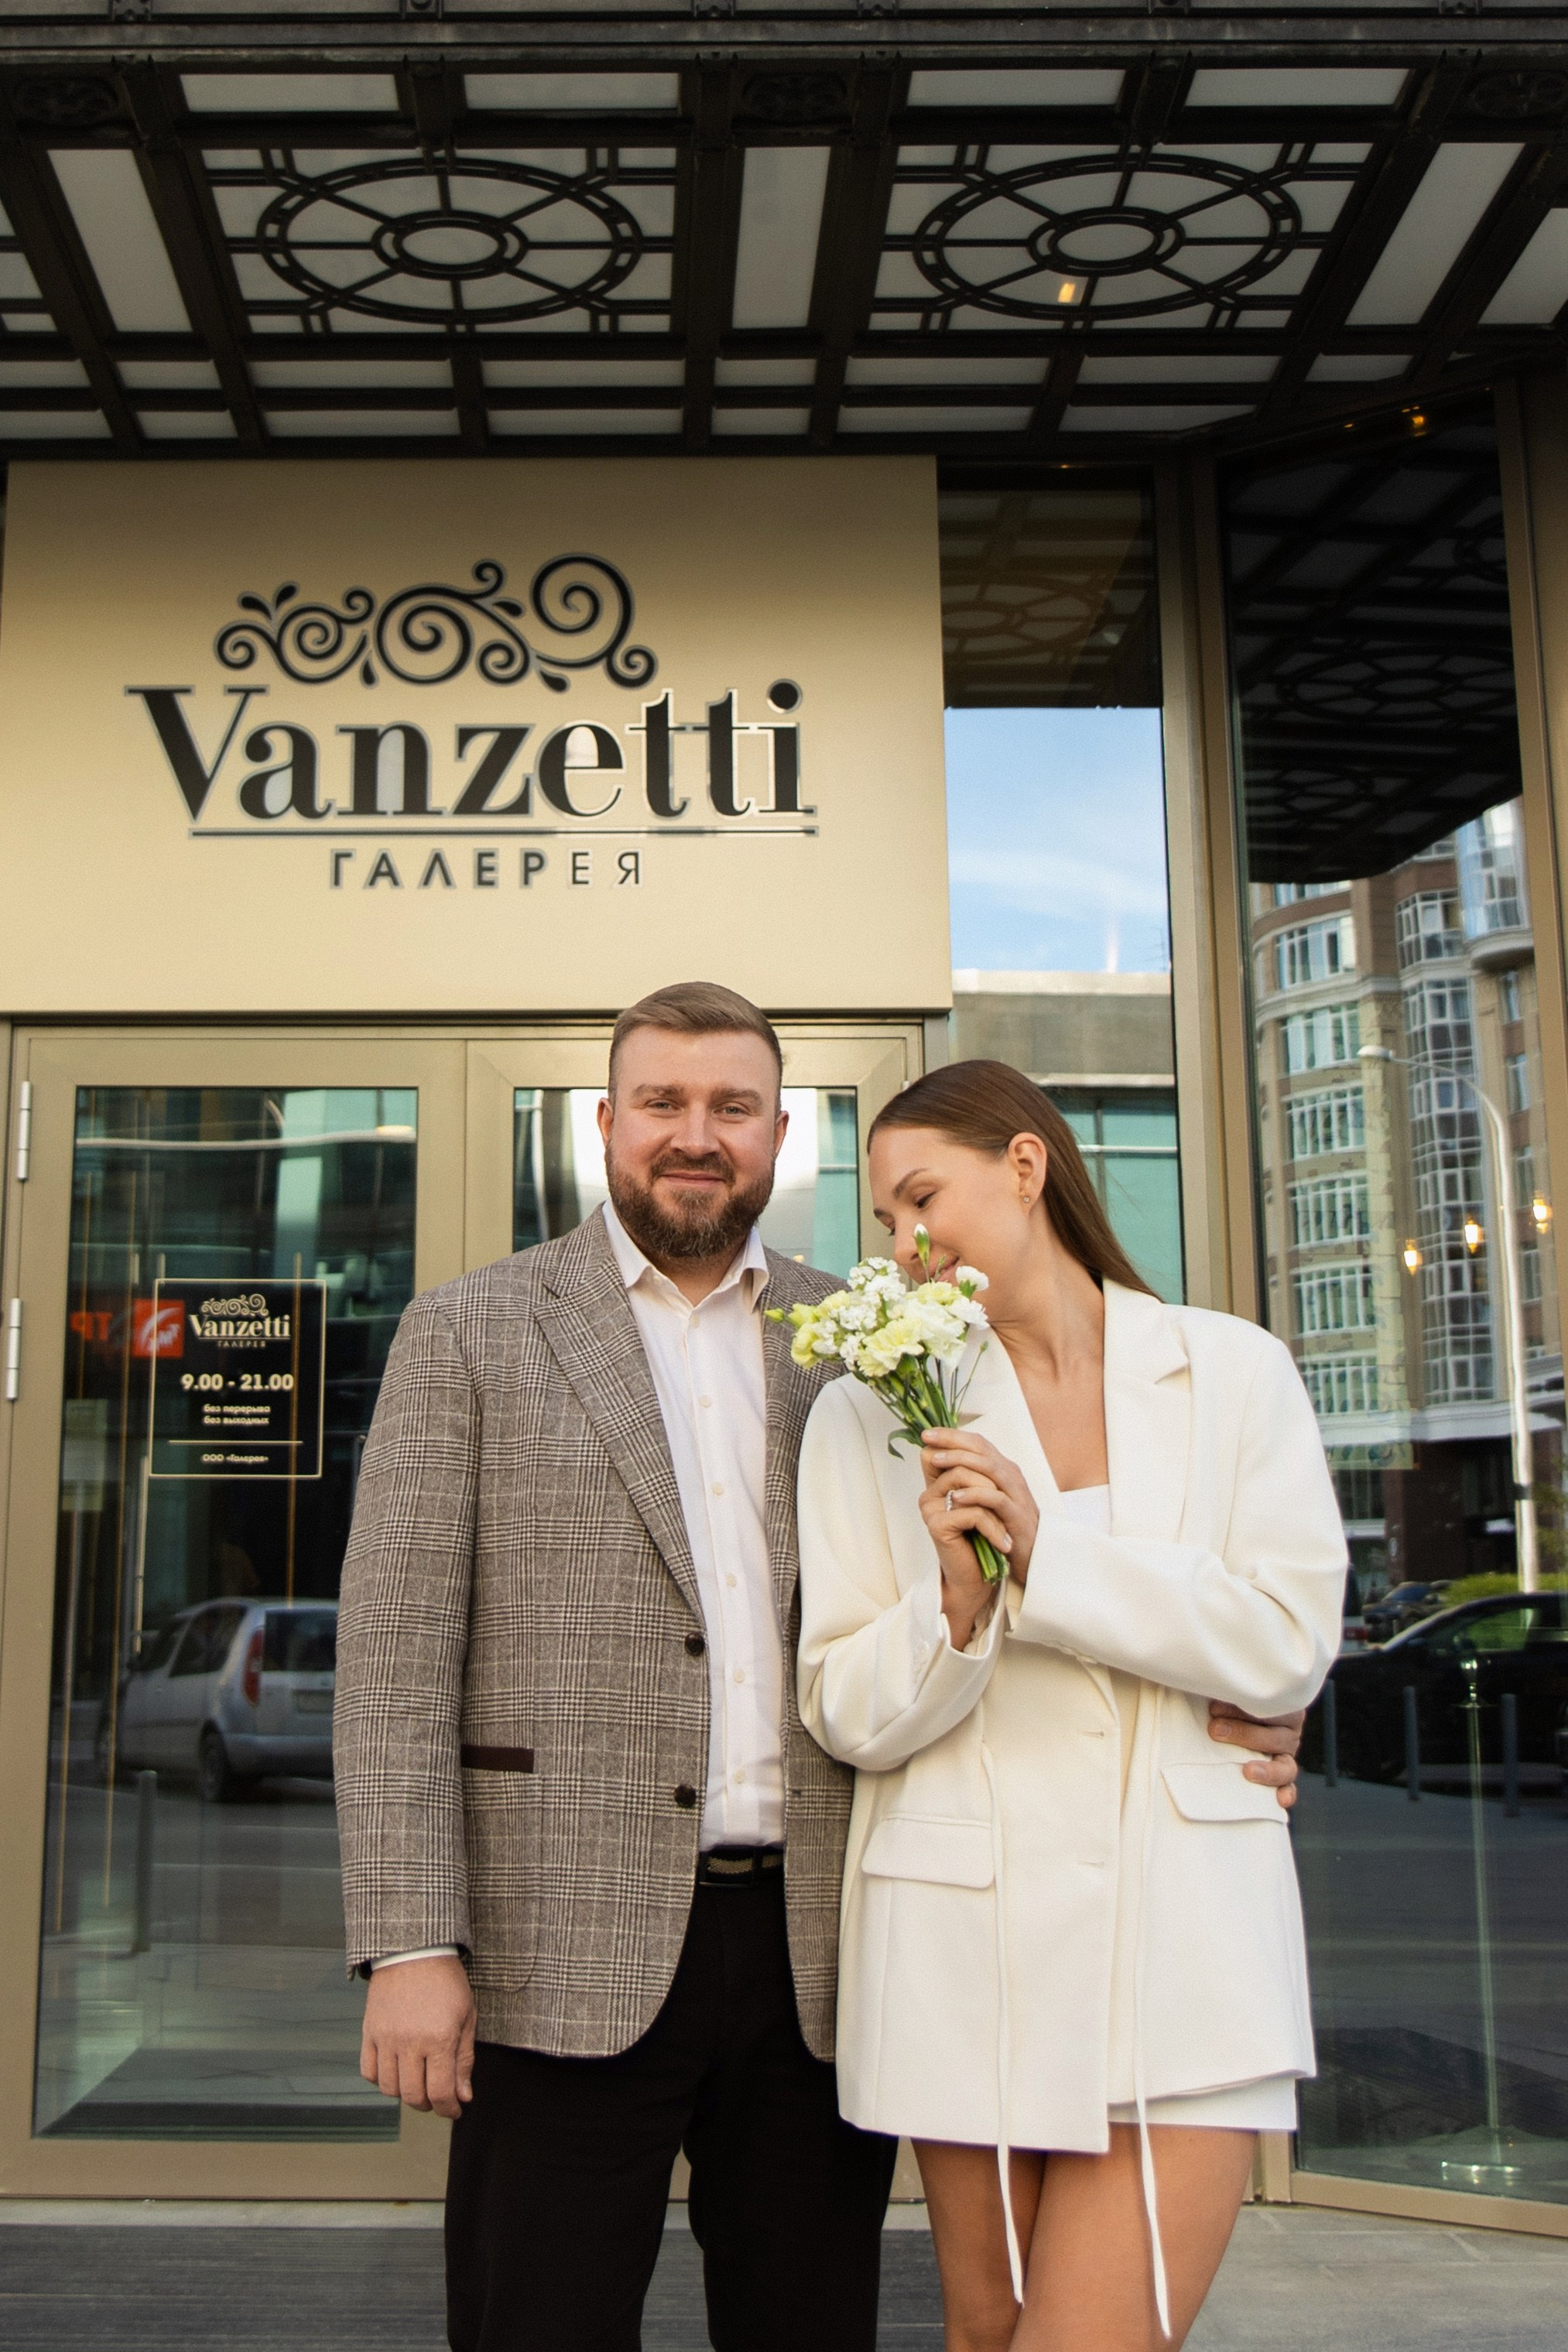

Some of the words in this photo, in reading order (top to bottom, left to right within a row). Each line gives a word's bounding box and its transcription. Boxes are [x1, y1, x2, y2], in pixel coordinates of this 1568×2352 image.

[125, 679, 817, 820] Vanzetti
[330, 850, 642, 888] ГАЛЕРЕЯ
[189, 1314, 291, 1337] Vanzetti
[181, 1373, 224, 1390] 9.00
[240, 1373, 294, 1390] 21.00
[204, 1404, 221, 1413] без
[223, 1405, 271, 1415] перерыва
[204, 1416, 221, 1424] без
[223, 1417, 269, 1426] выходных
[203, 1453, 224, 1462] ООО
